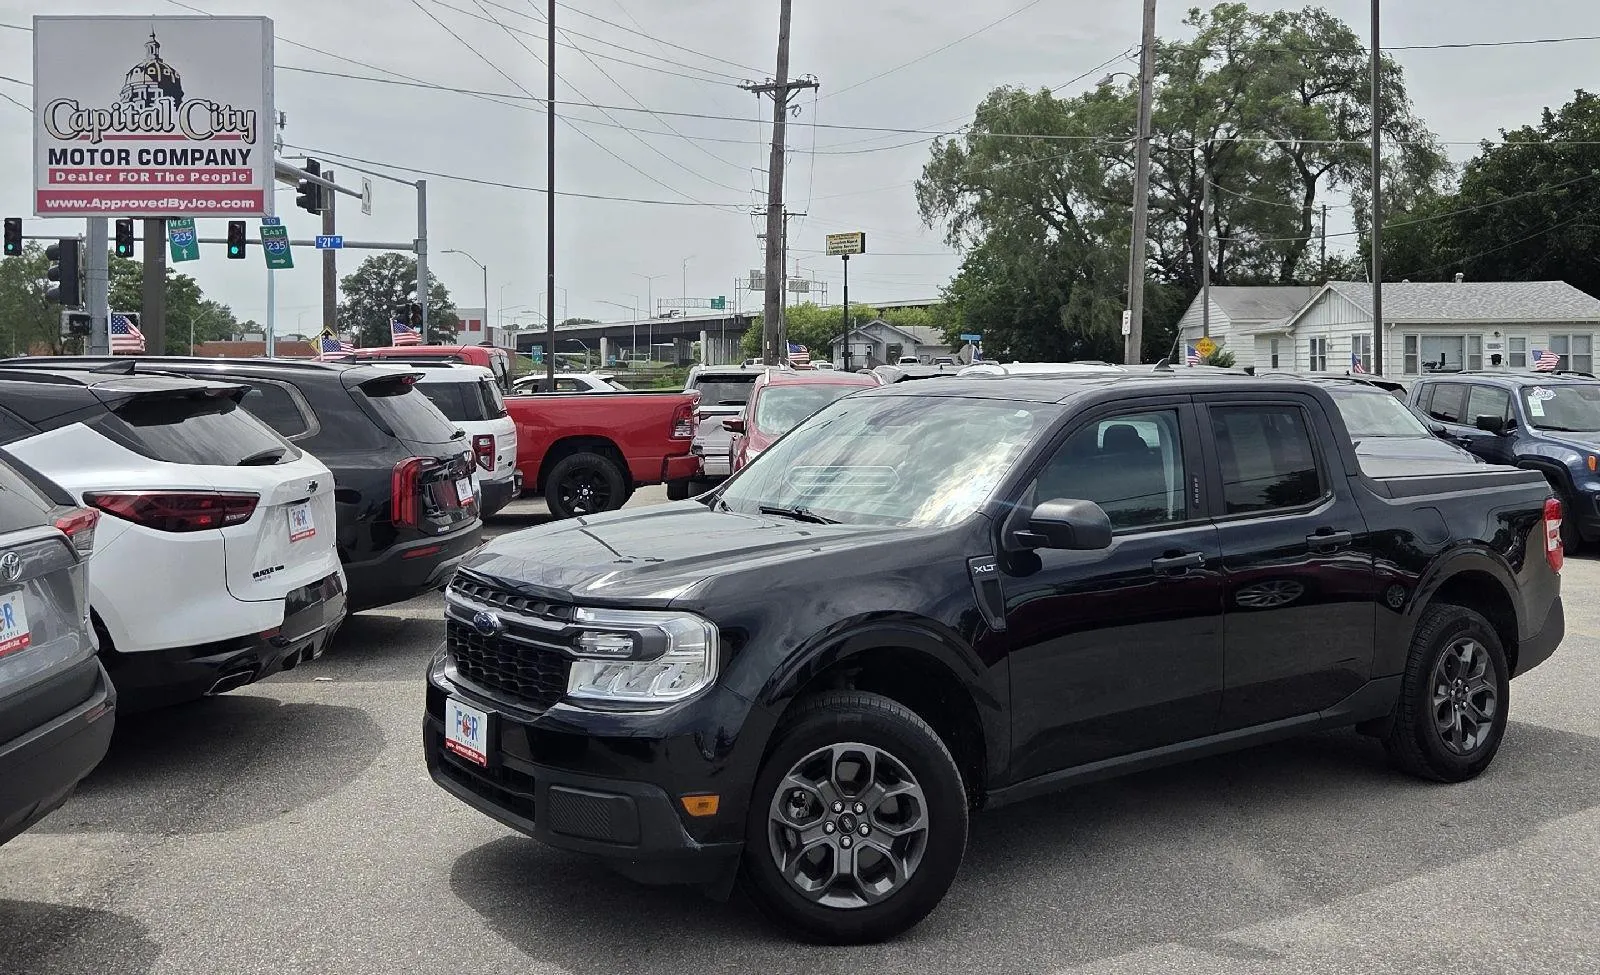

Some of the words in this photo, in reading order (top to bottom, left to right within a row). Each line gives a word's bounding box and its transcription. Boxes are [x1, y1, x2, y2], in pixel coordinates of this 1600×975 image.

[43, 98, 175, 144] Capital
[179, 98, 256, 144] City
[49, 148, 131, 166] MOTOR
[138, 148, 252, 166] COMPANY
[55, 172, 112, 182] Dealer
[119, 172, 150, 182] FOR
[155, 172, 185, 182] The
[190, 172, 247, 183] People
[45, 198, 255, 210] www.ApprovedByJoe.com
[169, 219, 191, 227] WEST
[173, 231, 193, 242] 235
[267, 241, 286, 250] 235
[973, 563, 997, 574] XLT
